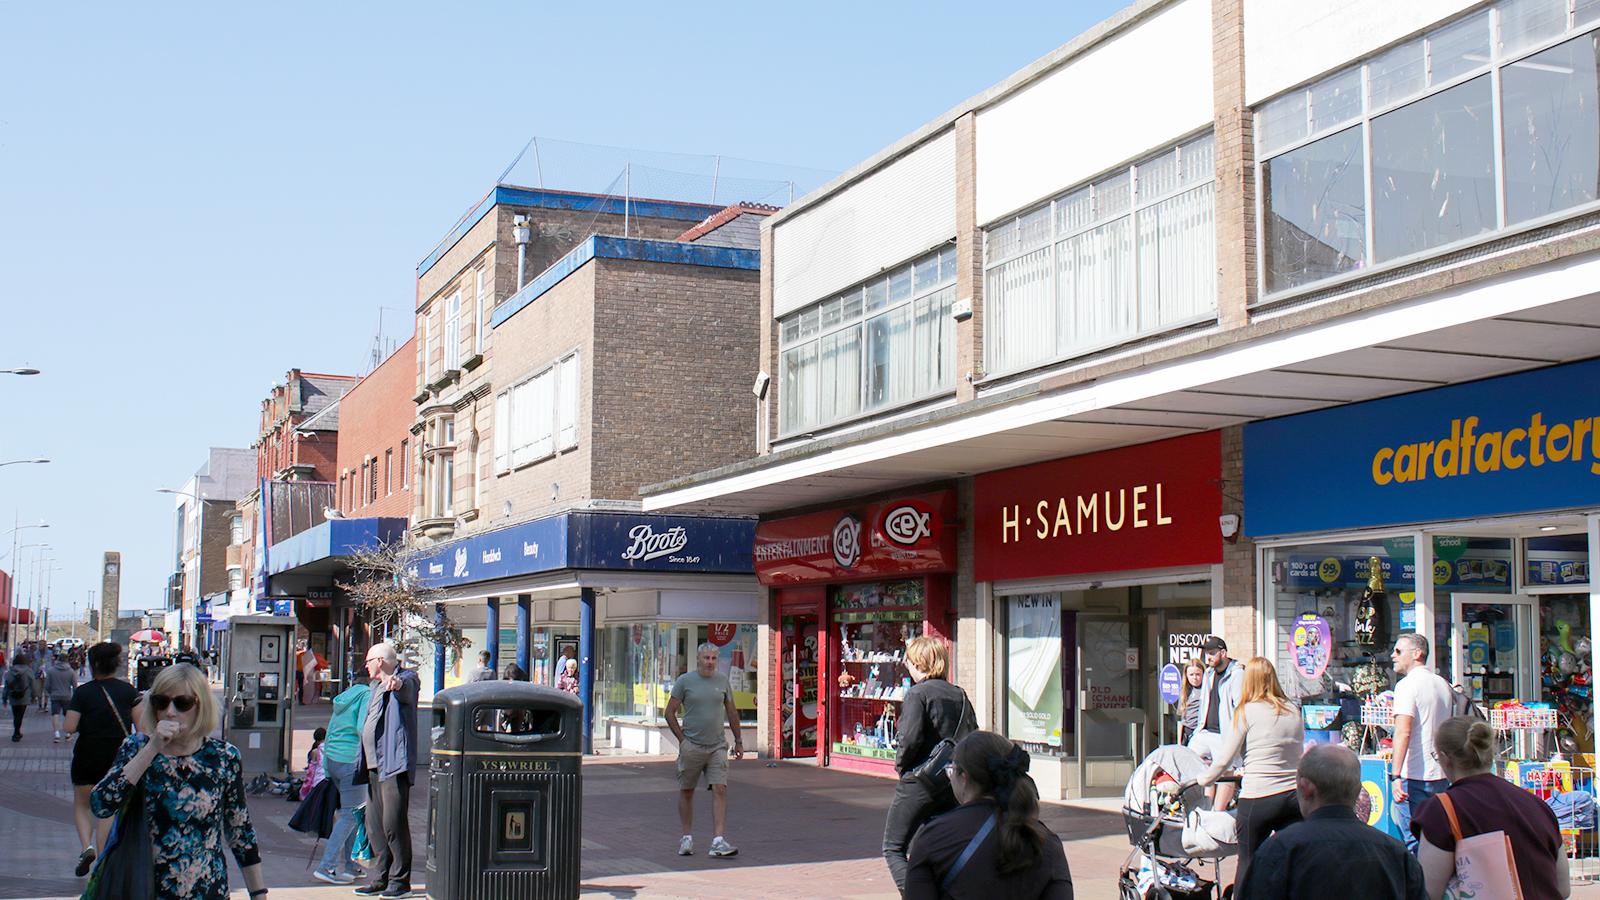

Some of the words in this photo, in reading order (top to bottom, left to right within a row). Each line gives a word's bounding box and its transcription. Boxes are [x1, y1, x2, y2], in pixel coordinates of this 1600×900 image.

[621, 524, 688, 562] Boots
[1439, 538, 1461, 547] school
[523, 541, 539, 559] Beauty
[756, 535, 831, 562] ENTERTAINMENT
[668, 555, 685, 563] Since
[686, 555, 700, 563] 1849
[1291, 562, 1308, 570] 100's
[1309, 562, 1317, 570] of
[1381, 561, 1391, 570] to
[1403, 564, 1415, 573] 100
[1289, 569, 1309, 577] cards
[1017, 595, 1040, 608] NEW
[1041, 595, 1053, 607] IN
[1169, 633, 1212, 646] DISCOVE
[1169, 646, 1202, 664] NEW
[1090, 686, 1112, 694] OLD
[482, 760, 551, 771] YSBWRIEL
